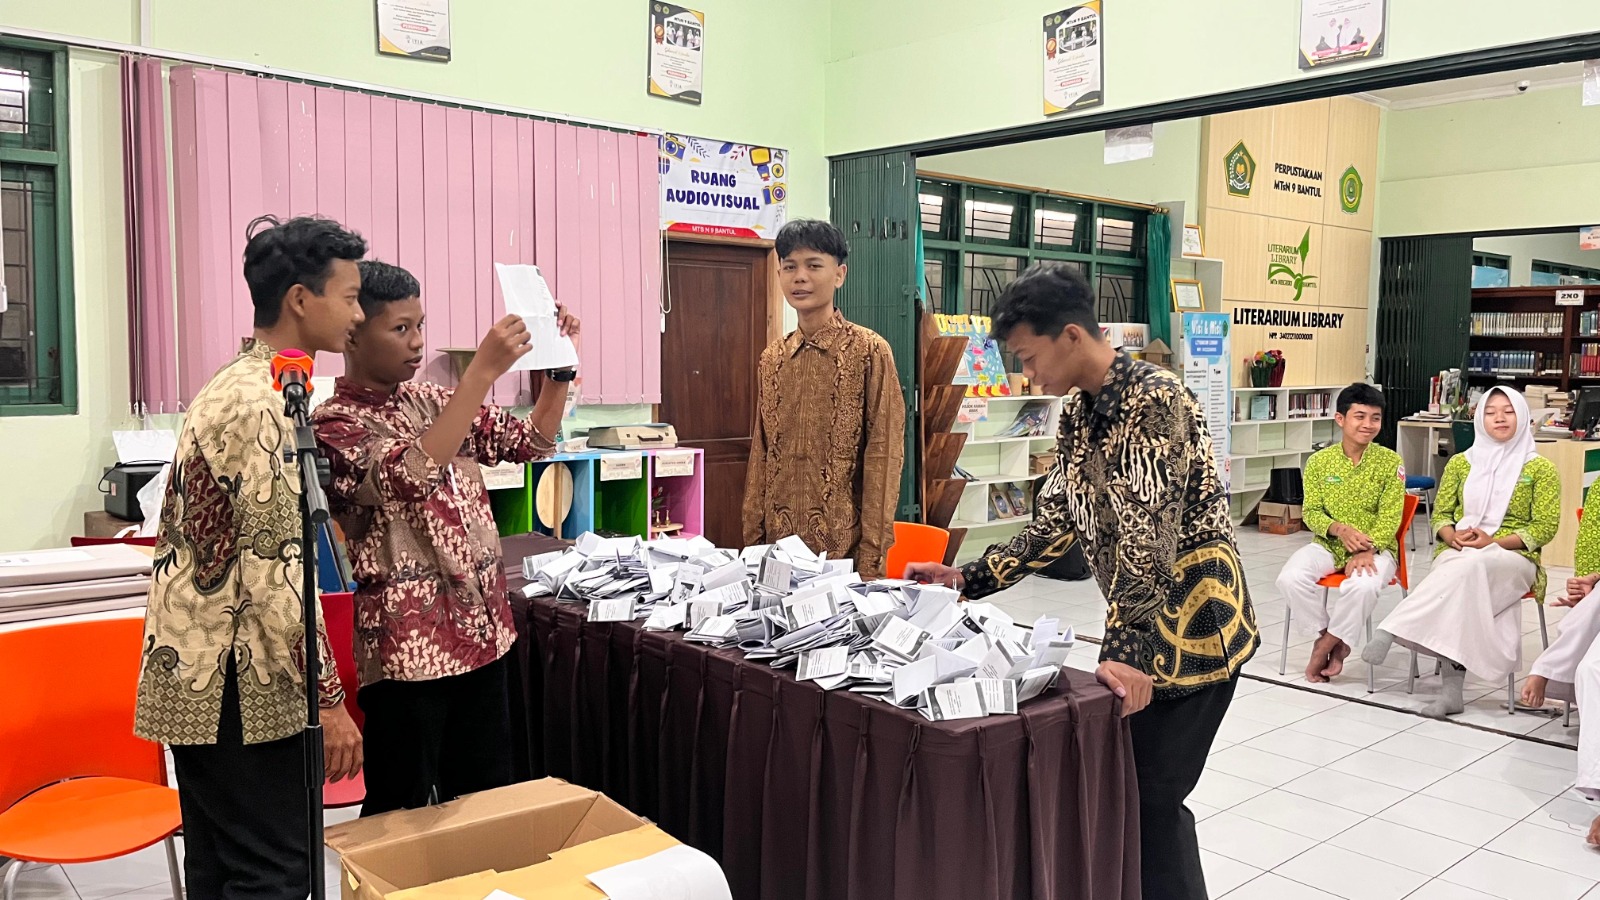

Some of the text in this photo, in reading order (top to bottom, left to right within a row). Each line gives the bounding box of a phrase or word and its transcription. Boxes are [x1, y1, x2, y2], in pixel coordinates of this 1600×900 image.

[690, 170, 736, 188] RUANG
[1274, 162, 1323, 181] PERPUSTAKAAN
[666, 188, 760, 210] AUDIOVISUAL
[1292, 182, 1296, 192] 9
[1297, 184, 1322, 198] BANTUL
[1267, 243, 1299, 255] LITERARIUM
[1271, 253, 1298, 265] LIBRARY
[1233, 307, 1344, 329] LITERARIUM LIBRARY
